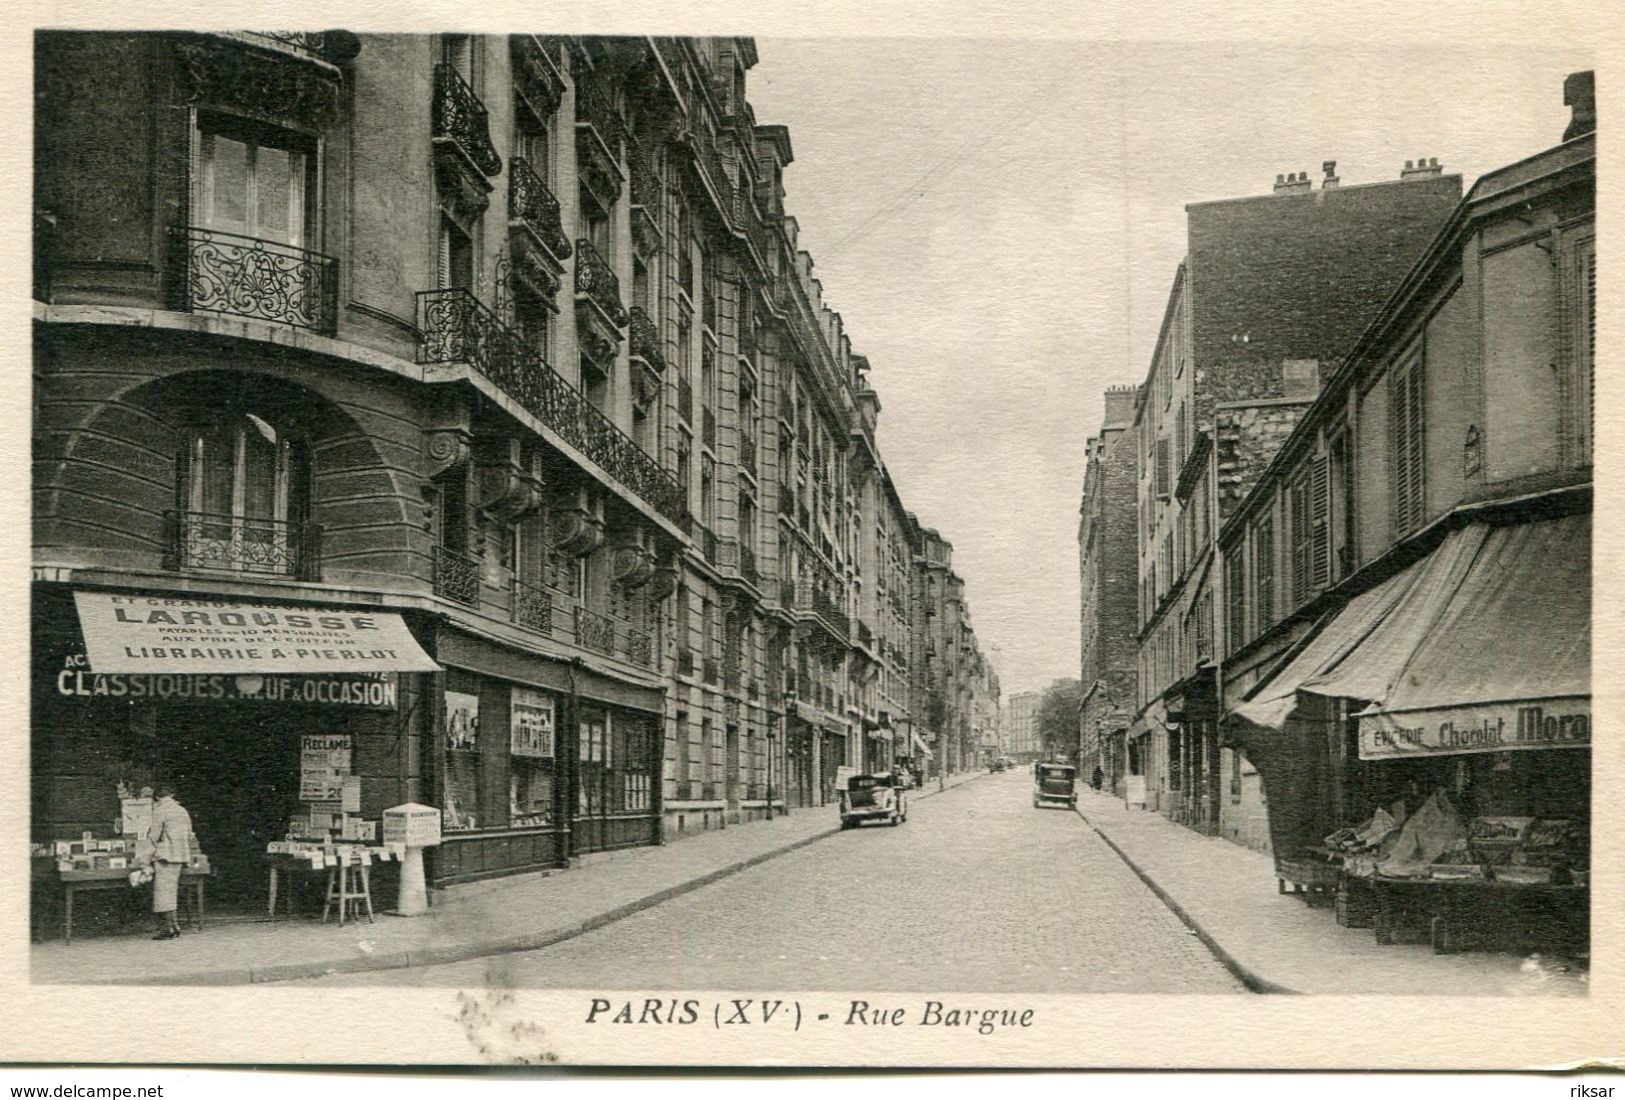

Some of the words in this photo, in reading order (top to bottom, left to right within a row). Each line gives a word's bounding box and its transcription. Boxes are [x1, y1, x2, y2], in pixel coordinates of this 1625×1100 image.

[114, 608, 379, 630] LAROUSSE
[158, 627, 222, 635] PAYABLES
[124, 646, 262, 660] LIBRAIRIE
[303, 680, 398, 706] OCCASION
[1439, 717, 1506, 746] Chocolat
[1517, 706, 1591, 740] Mora
[303, 738, 351, 750] RECLAME
